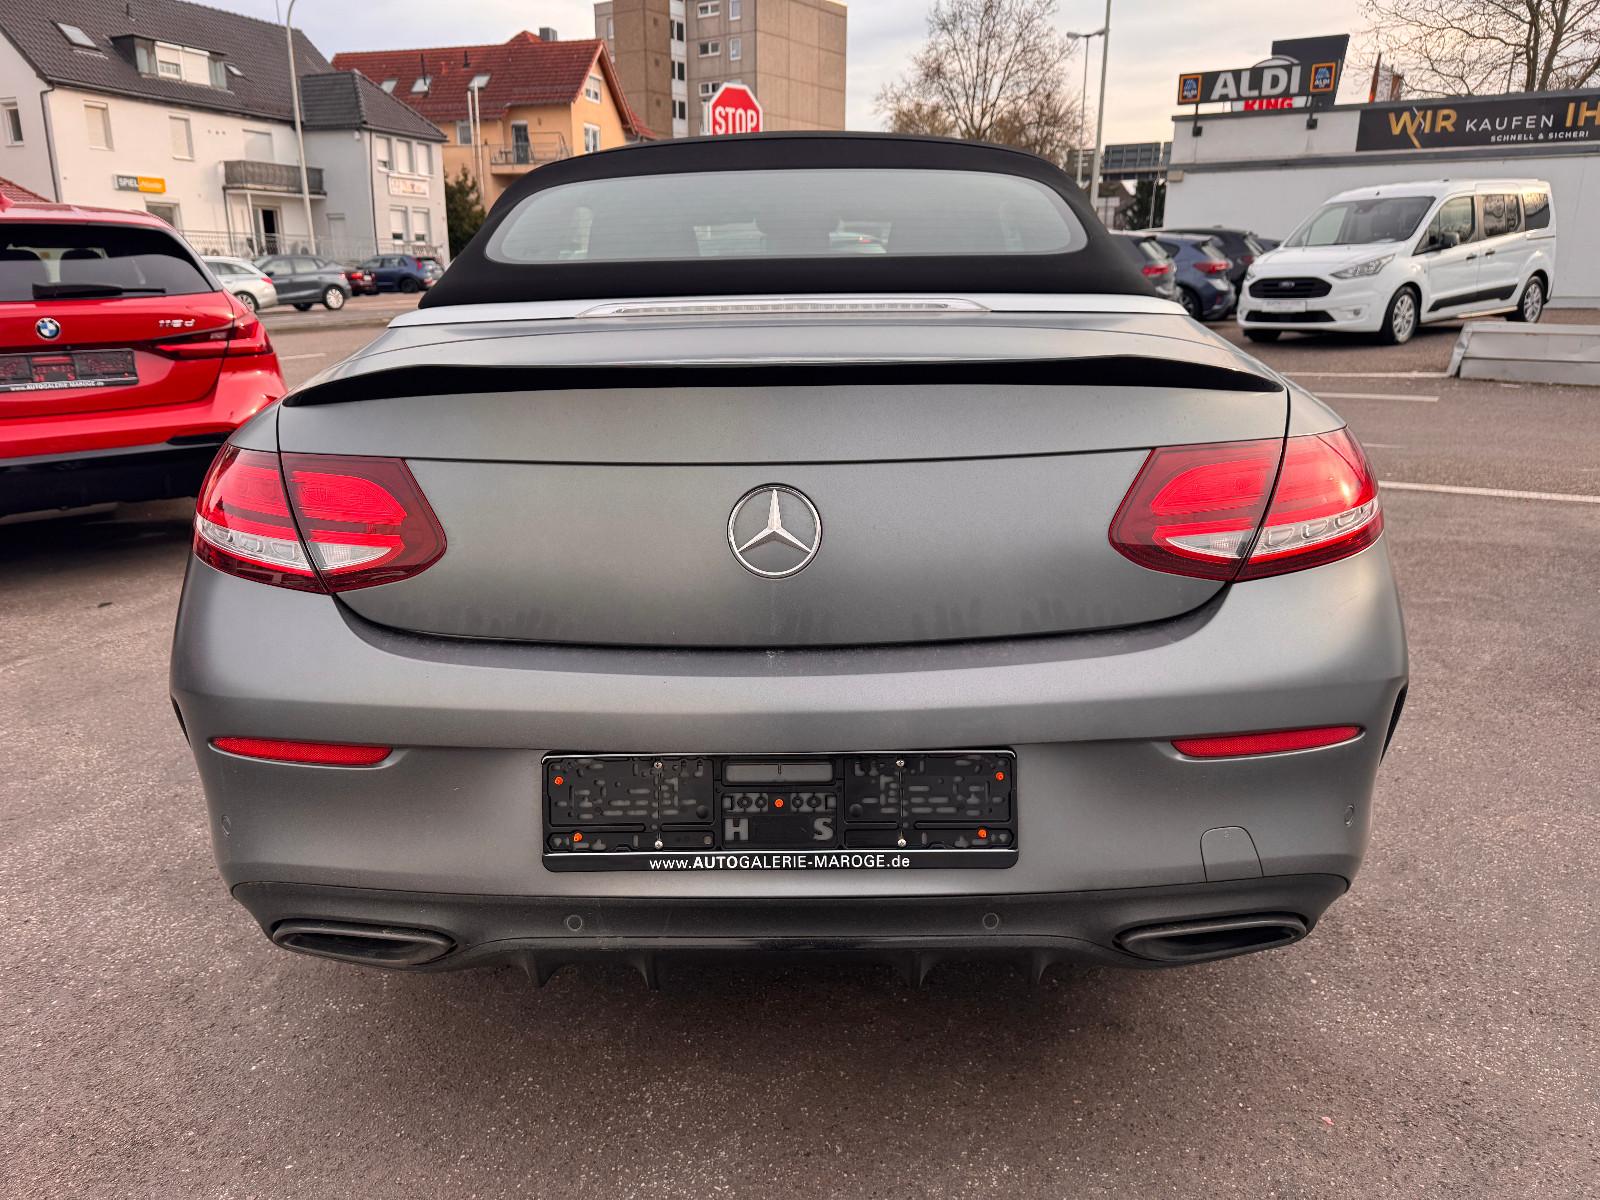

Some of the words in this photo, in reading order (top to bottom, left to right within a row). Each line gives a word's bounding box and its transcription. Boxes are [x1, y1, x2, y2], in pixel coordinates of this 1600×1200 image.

[1210, 65, 1302, 100] ALDI
[1243, 97, 1295, 111] KING
[714, 105, 758, 135] STOP
[1388, 107, 1458, 149] WIR
[1465, 114, 1555, 133] KAUFEN
[1490, 132, 1534, 143] SCHNELL
[649, 854, 910, 870] www.AUTOGALERIE-MAROGE.de
